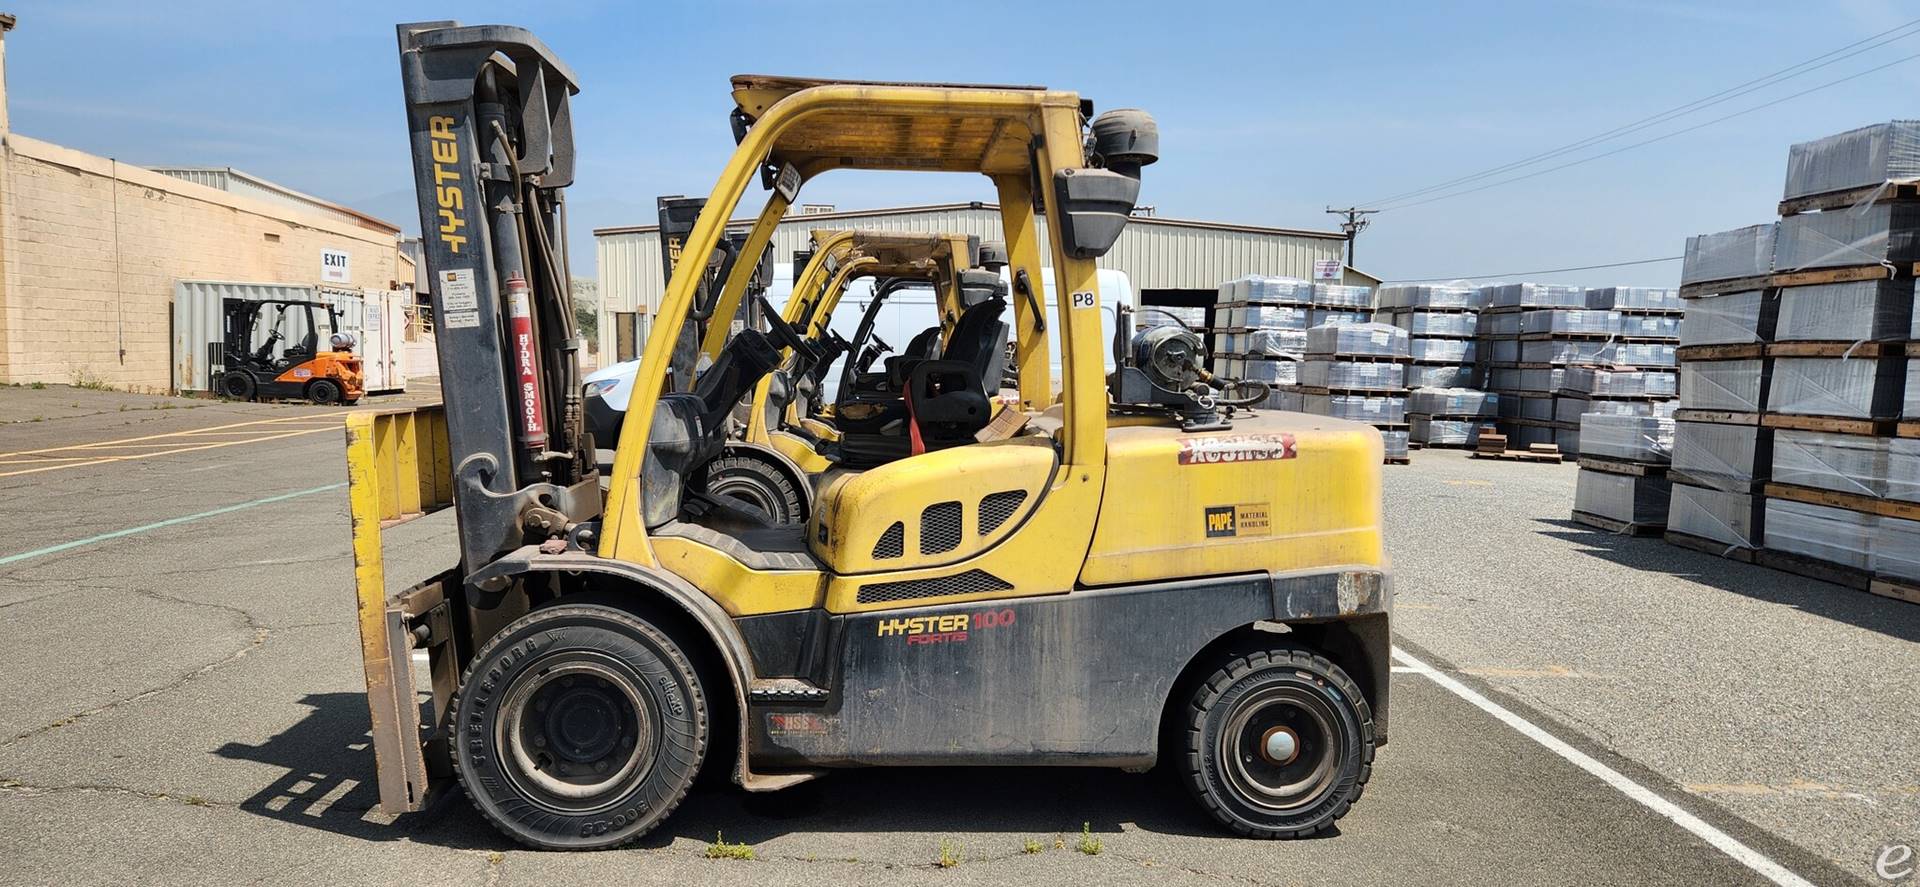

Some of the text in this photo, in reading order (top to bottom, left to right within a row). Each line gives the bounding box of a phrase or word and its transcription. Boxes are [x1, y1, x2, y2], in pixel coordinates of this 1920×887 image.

[429, 115, 467, 253] HYSTER
[324, 253, 346, 268] EXIT
[1073, 292, 1094, 307] P8
[518, 333, 538, 432] HYDRA SMOOTH
[1240, 511, 1268, 519] MATERIAL
[1240, 520, 1269, 528] HANDLING
[877, 608, 1016, 637] HYSTER 100
[907, 631, 968, 646] FORTIS
